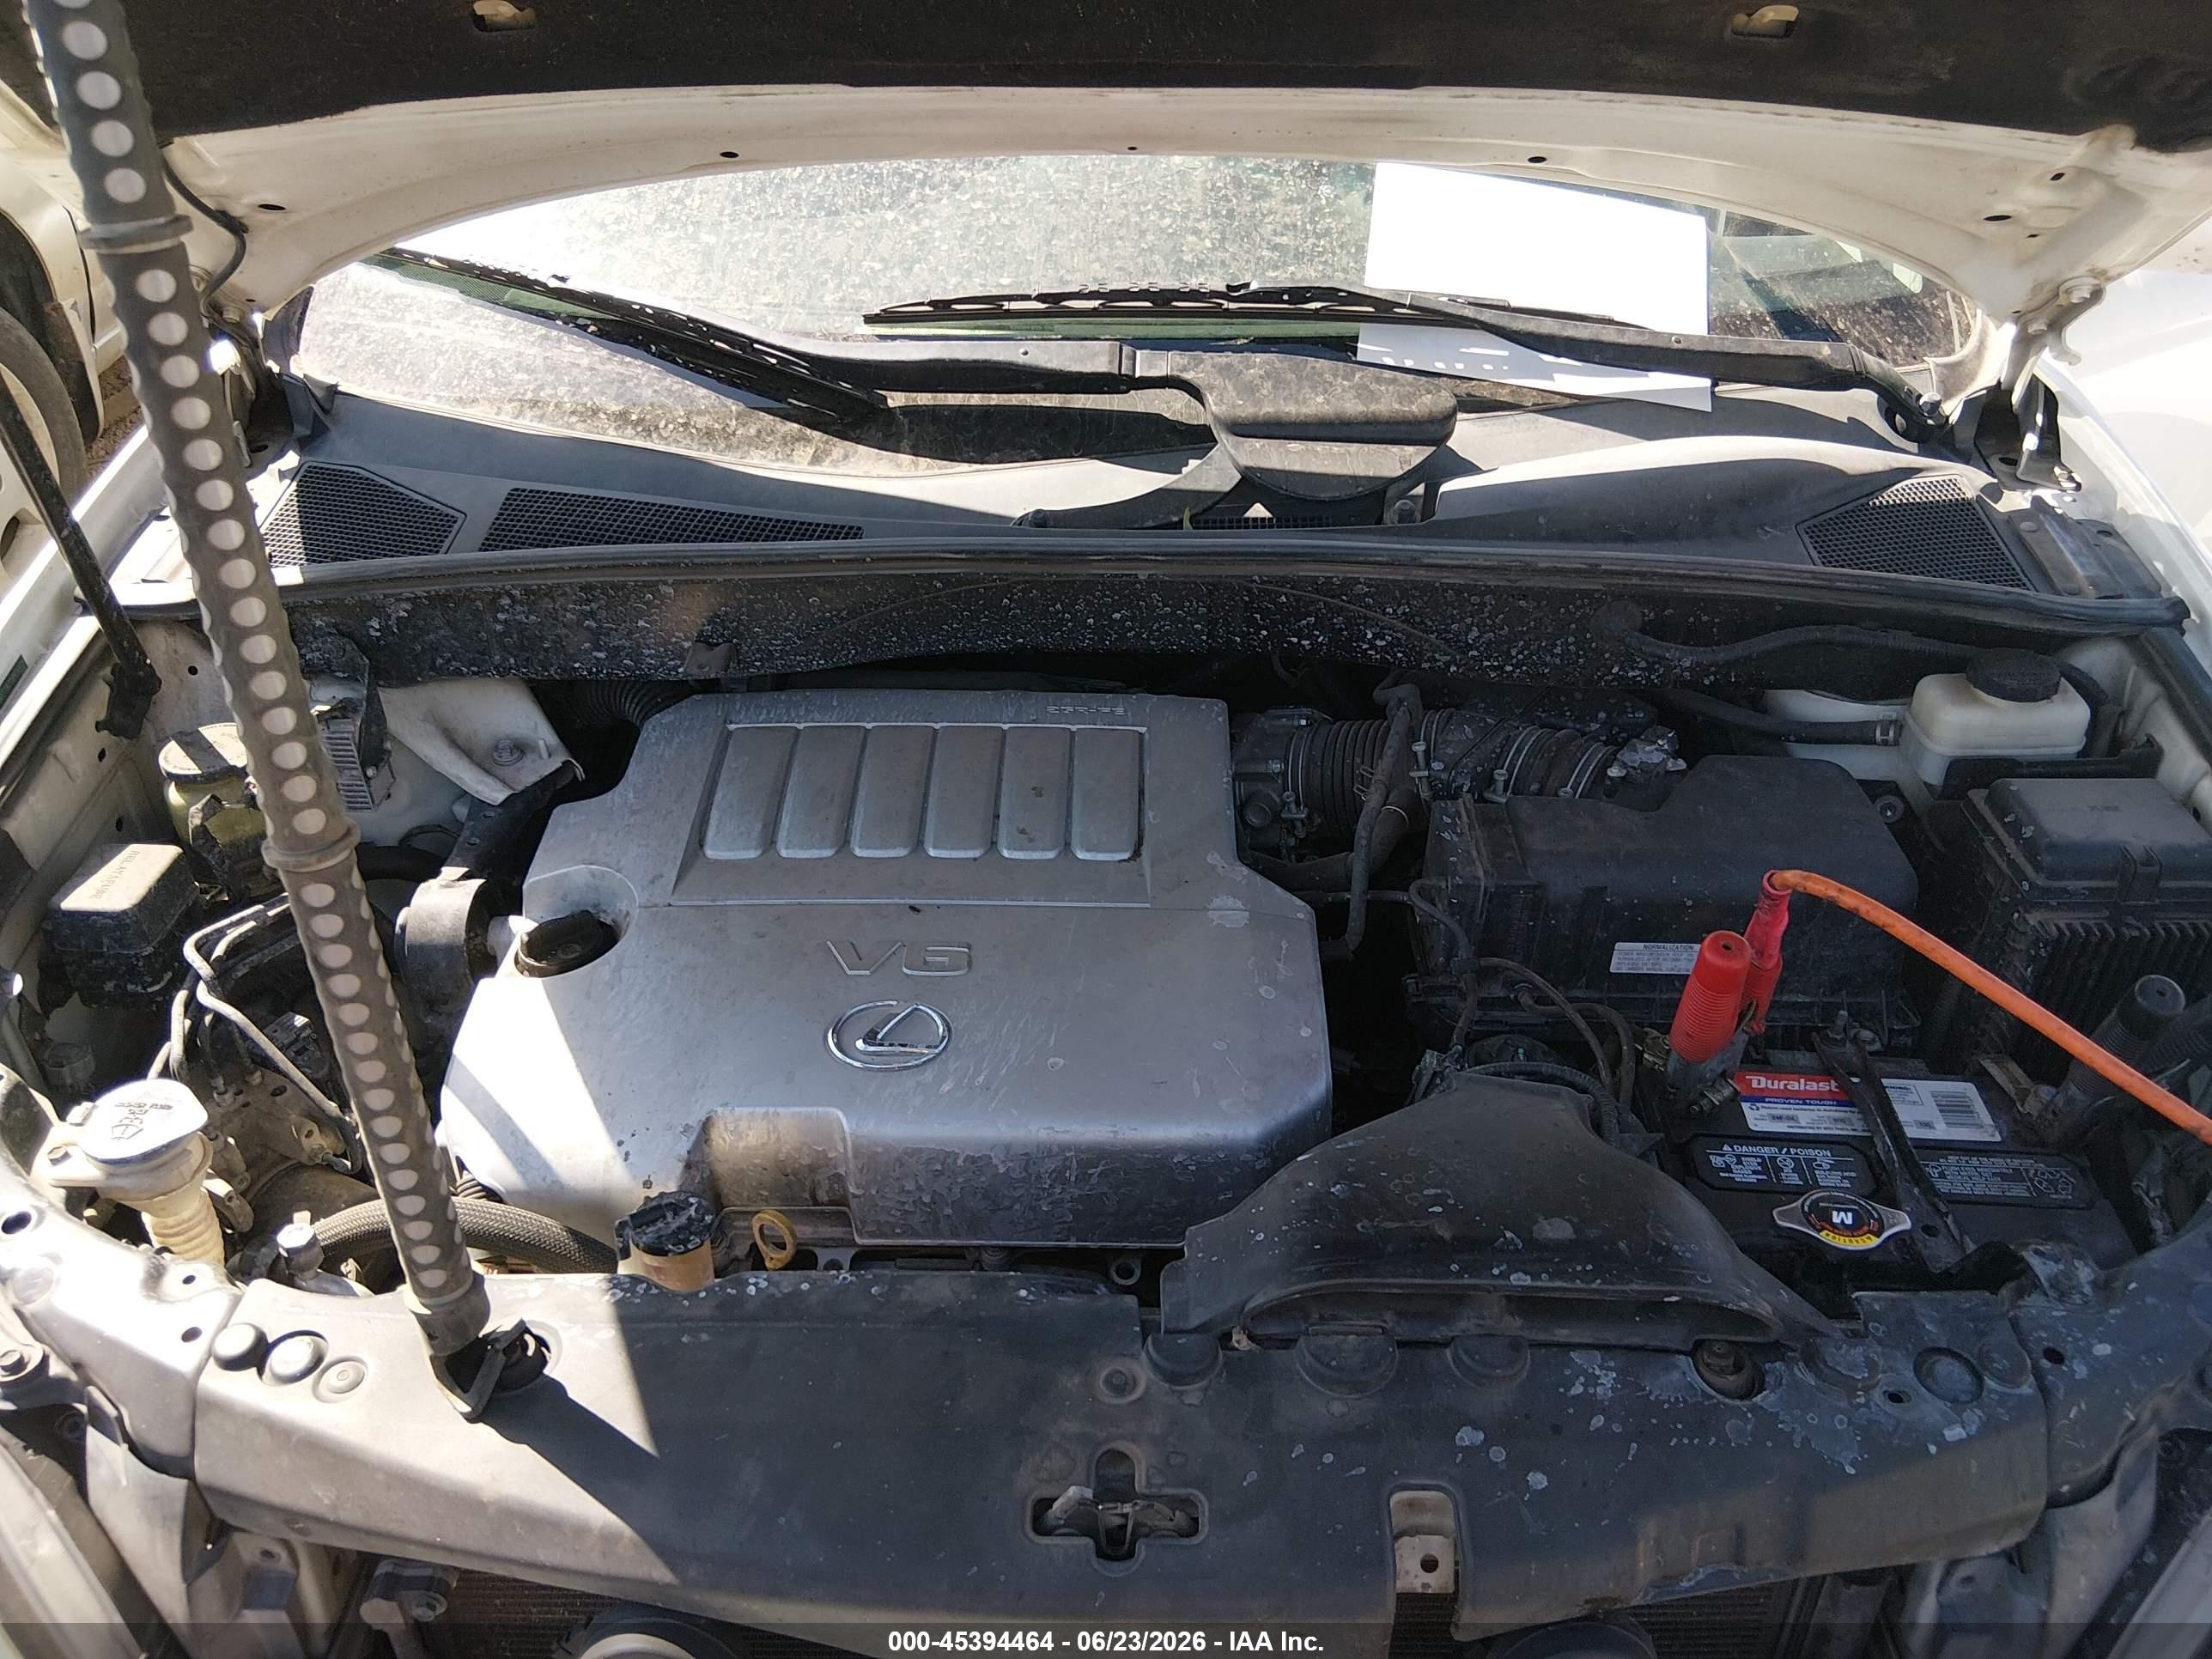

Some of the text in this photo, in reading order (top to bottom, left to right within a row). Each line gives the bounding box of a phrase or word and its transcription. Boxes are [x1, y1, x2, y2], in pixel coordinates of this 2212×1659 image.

[826, 940, 971, 976] V6
[1745, 1075, 1840, 1092] Duralast
[1734, 1145, 1779, 1154] DANGER
[1790, 1147, 1832, 1158] POISON
[1825, 1231, 1869, 1243] CAUTION
